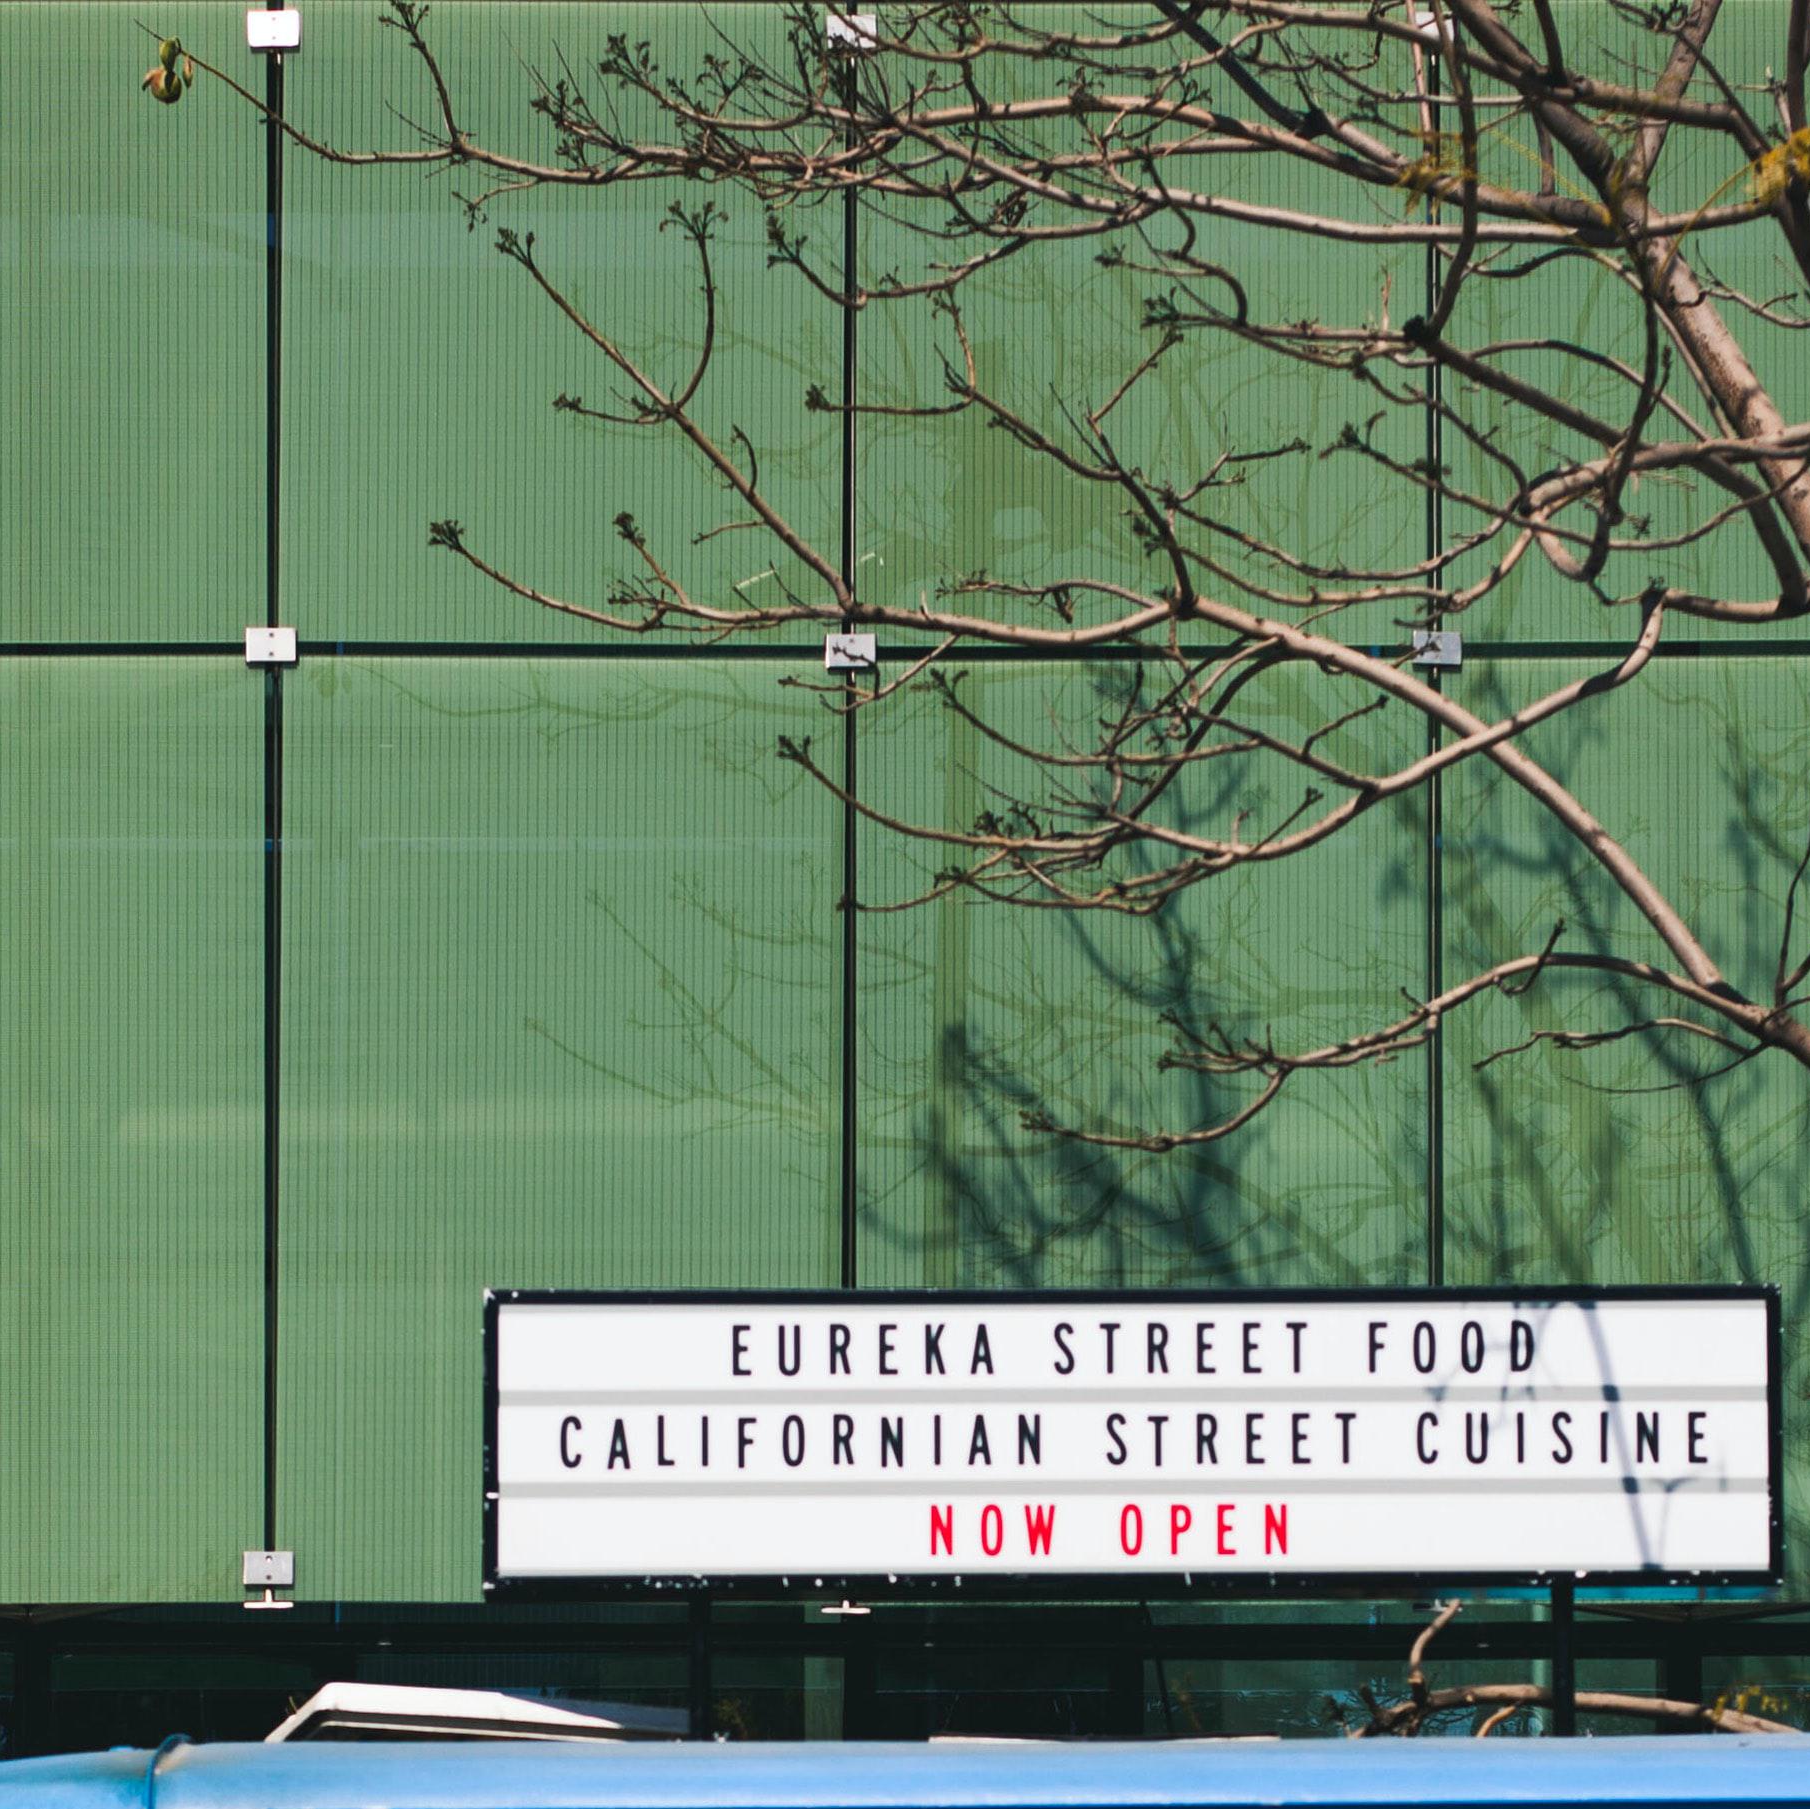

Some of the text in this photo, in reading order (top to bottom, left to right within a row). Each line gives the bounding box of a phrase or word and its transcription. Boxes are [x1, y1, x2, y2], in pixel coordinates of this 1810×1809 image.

[733, 1319, 1536, 1376] EUREKA STREET FOOD
[560, 1411, 1708, 1470] CALIFORNIAN STREET CUISINE
[931, 1504, 1287, 1556] NOW OPEN
